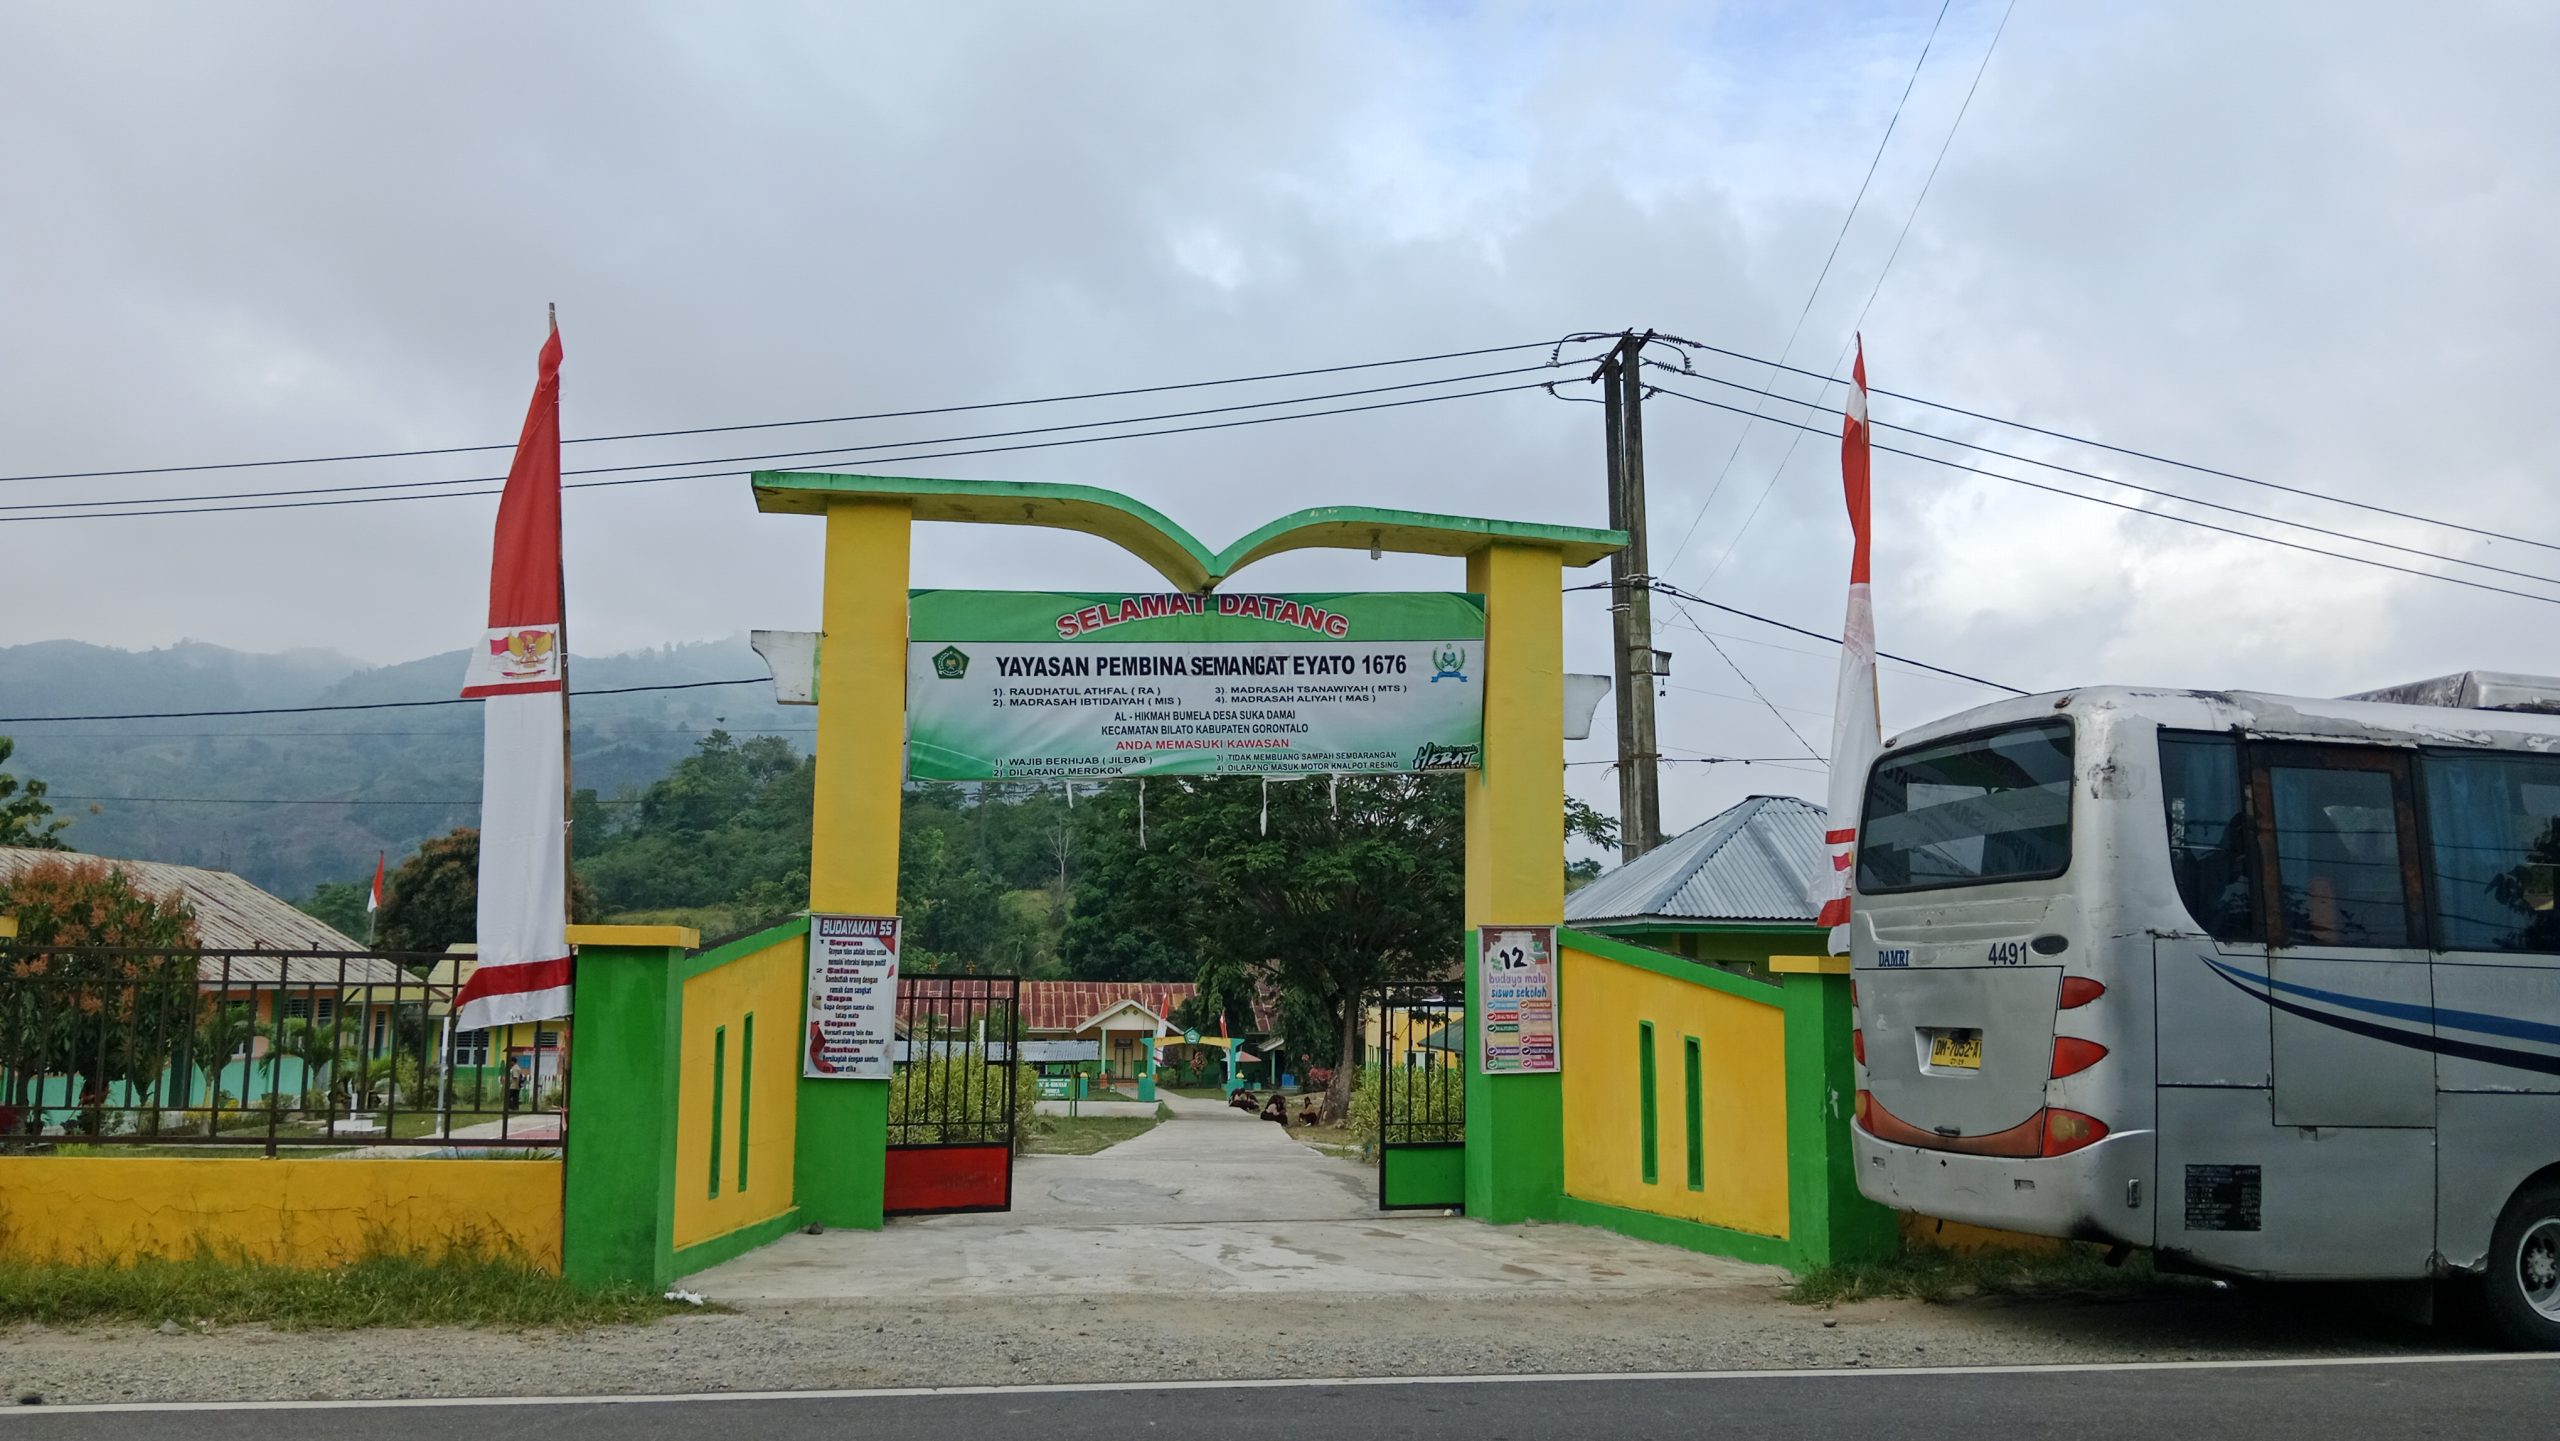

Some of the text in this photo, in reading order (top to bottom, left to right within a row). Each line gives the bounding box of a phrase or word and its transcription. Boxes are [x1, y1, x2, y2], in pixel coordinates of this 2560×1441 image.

[1056, 593, 1349, 639] SELAMAT DATANG
[996, 654, 1407, 677] YAYASAN PEMBINA SEMANGAT EYATO 1676
[1009, 687, 1081, 696] RAUDHATUL
[1083, 687, 1128, 696] ATHFAL
[1230, 686, 1294, 694] MADRASAH
[1296, 685, 1369, 693] TSANAWIYAH
[1009, 698, 1077, 706] MADRASAH
[1080, 697, 1145, 706] IBTIDAIYAH
[1230, 695, 1294, 703] MADRASAH
[1296, 695, 1336, 703] ALIYAH
[1134, 711, 1171, 721] HIKMAH
[1173, 710, 1211, 721] BUMELA
[1213, 710, 1238, 720] DESA
[1239, 710, 1265, 720] SUKA
[1266, 709, 1296, 720] DAMAI
[1101, 723, 1309, 735] KECAMATAN BILATO KABUPATEN GORONTALO
[1116, 738, 1289, 750] ANDA MEMASUKI KAWASAN
[1009, 757, 1043, 766] WAJIB
[1045, 757, 1099, 766] BERHIJAB
[1228, 753, 1252, 762] TIDAK
[1253, 753, 1300, 761] MEMBUANG
[1301, 752, 1334, 760] SAMPAH
[1335, 751, 1397, 760] SEMBARANGAN
[1009, 768, 1065, 777] DILARANG
[1068, 767, 1123, 776] MEROKOK
[1228, 763, 1269, 772] DILARANG
[1270, 762, 1298, 771] MASUK
[1300, 762, 1330, 771] MOTOR
[1331, 761, 1368, 770] KNALPOT
[1369, 761, 1399, 770] RESING
[821, 919, 877, 935] BUDAYAKAN
[1499, 946, 1528, 970] 12
[1878, 941, 2028, 968] DAMRI 4491
[827, 967, 860, 975] Salam
[1489, 972, 1546, 987] budaya malu
[1491, 986, 1547, 998] siswa sekolah
[826, 994, 853, 1002] Sapa
[823, 1046, 860, 1054] Santun
